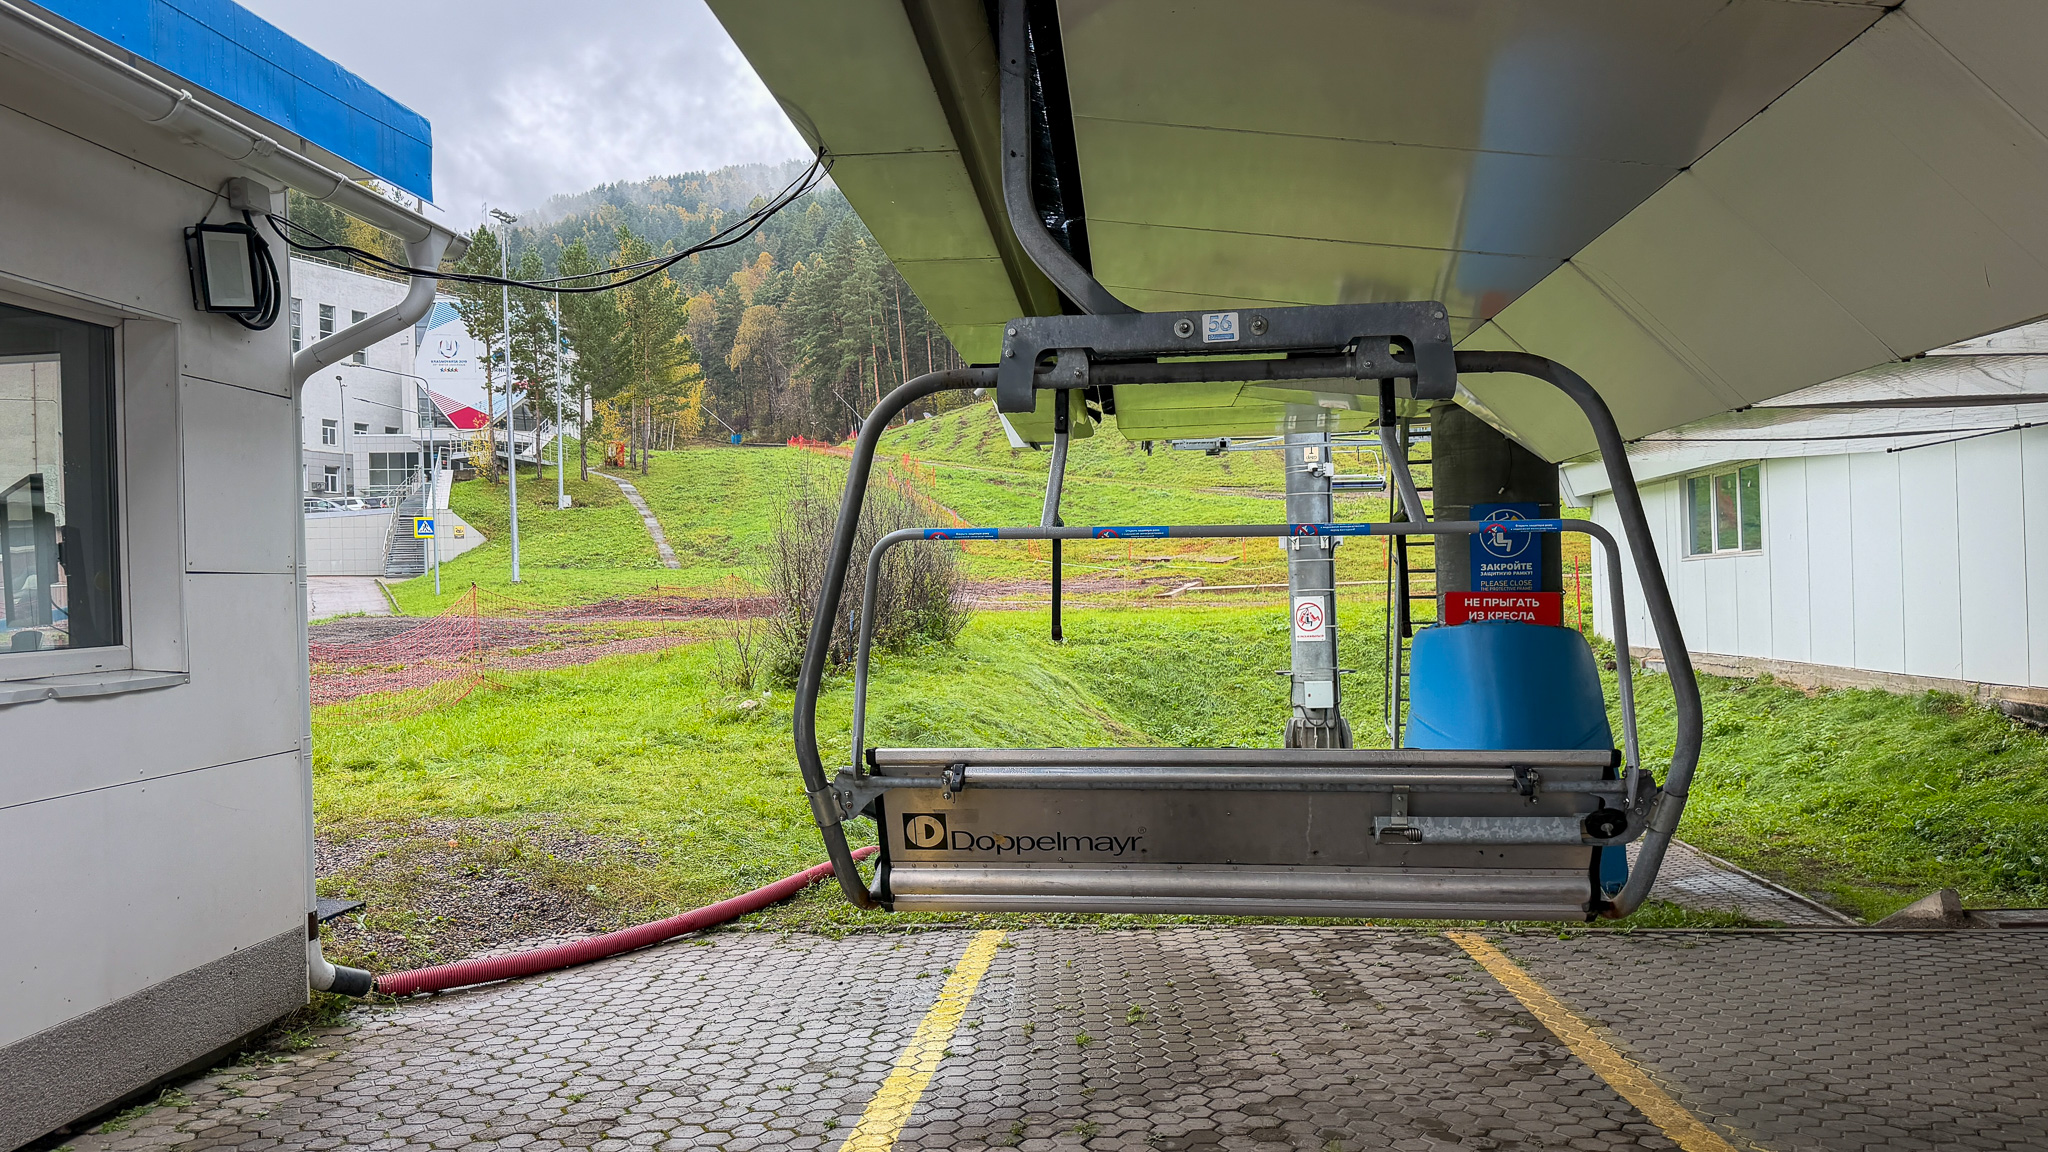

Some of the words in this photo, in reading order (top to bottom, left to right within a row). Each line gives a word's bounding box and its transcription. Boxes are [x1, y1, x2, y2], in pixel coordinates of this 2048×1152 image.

[1208, 314, 1232, 333] 56
[1480, 561, 1533, 571] ЗАКРОЙТЕ
[1464, 598, 1480, 607] НЕ
[1483, 598, 1540, 607] ПРЫГАТЬ
[1468, 611, 1485, 620] ИЗ
[1488, 611, 1535, 620] КРЕСЛА
[951, 830, 1143, 857] Doppelmayr
